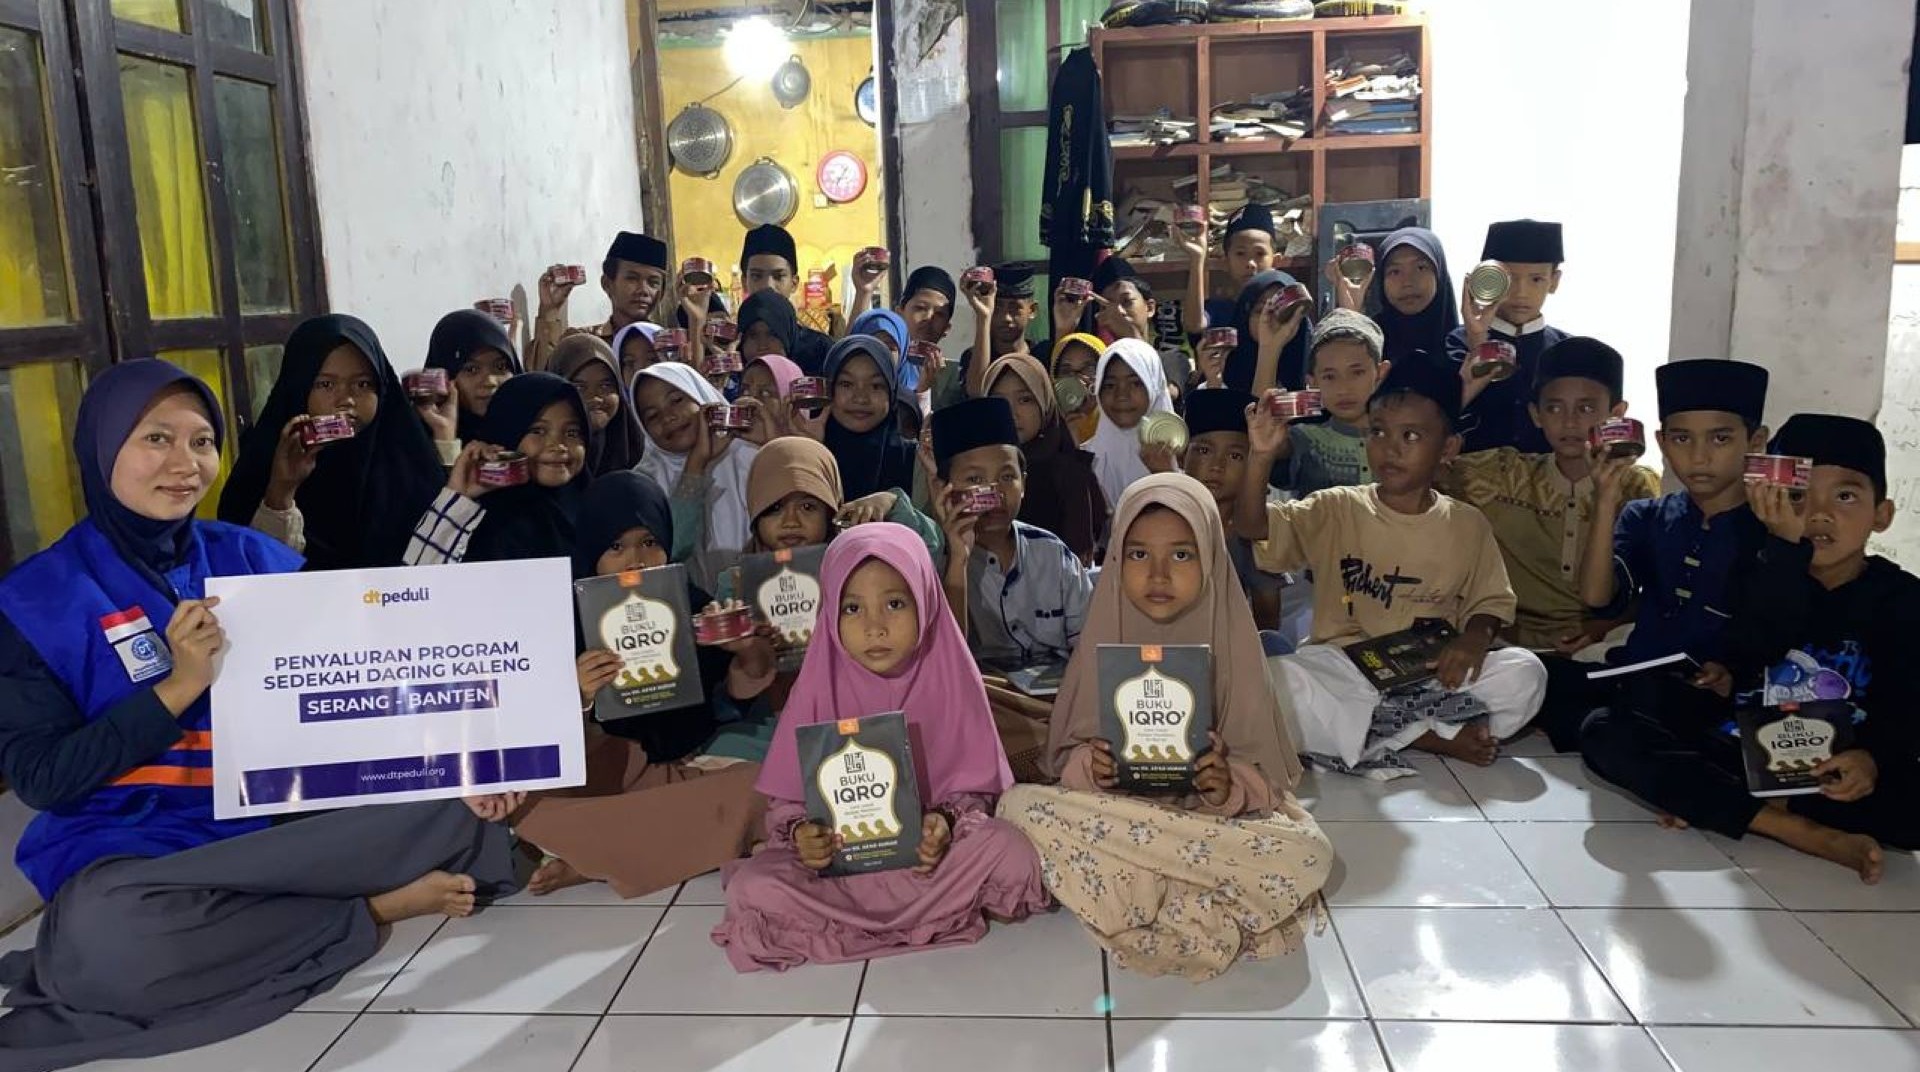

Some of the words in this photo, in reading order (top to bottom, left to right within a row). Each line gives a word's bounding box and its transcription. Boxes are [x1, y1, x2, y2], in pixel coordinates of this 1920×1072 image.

[774, 591, 805, 603] BUKU
[622, 620, 656, 635] BUKU
[274, 647, 412, 671] PENYALURAN
[418, 641, 520, 662] PROGRAM
[264, 670, 360, 690] SEDEKAH
[366, 663, 446, 682] DAGING
[452, 657, 531, 676] KALENG
[307, 694, 390, 715] SERANG
[409, 687, 491, 708] BANTEN
[1136, 700, 1173, 709] BUKU
[1129, 710, 1186, 726] IQRO'
[361, 765, 446, 783] www.dtpeduli.org
[840, 772, 875, 787] BUKU
[833, 781, 890, 805] IQRO'
